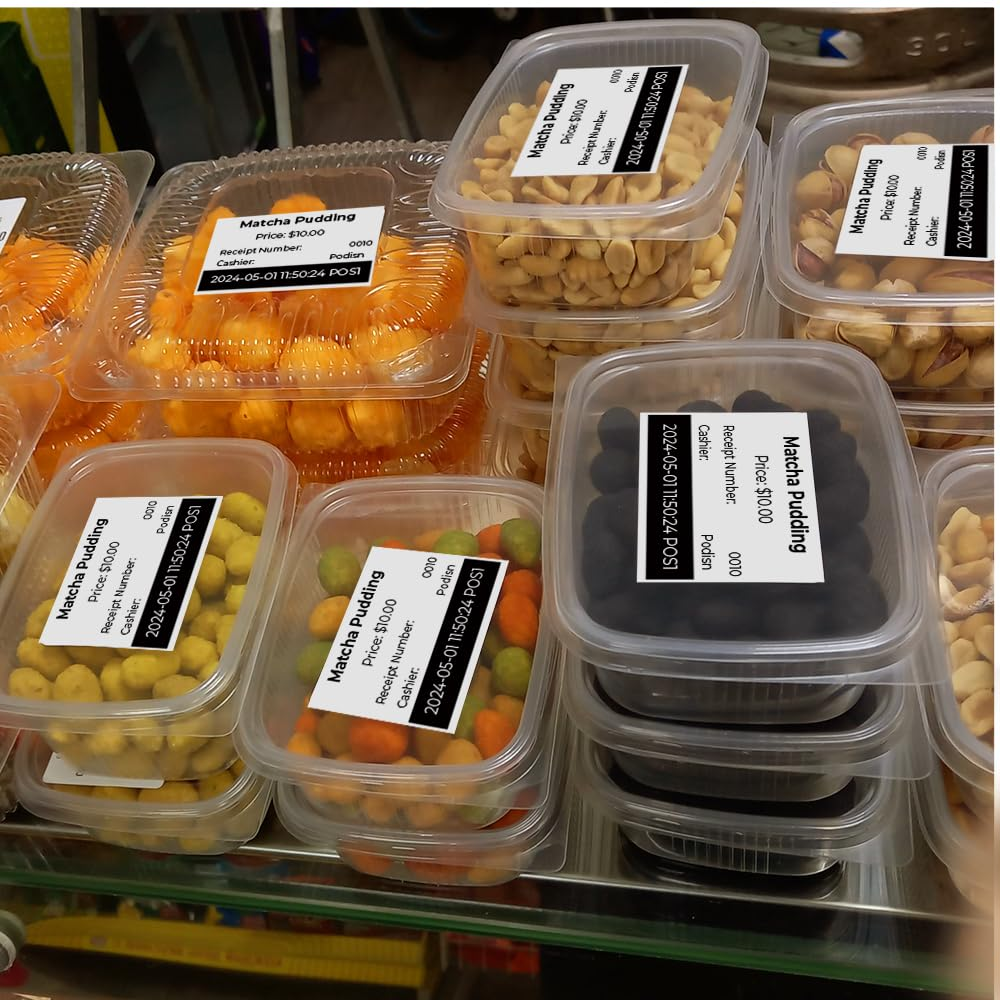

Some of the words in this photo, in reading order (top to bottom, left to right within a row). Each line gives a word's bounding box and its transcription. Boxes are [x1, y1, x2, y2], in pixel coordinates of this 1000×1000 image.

[527, 123, 554, 158] Matcha
[543, 84, 574, 121] Pudding
[568, 99, 588, 122] $10.00
[598, 138, 616, 165] Cashier:
[624, 73, 640, 92] Podisn
[626, 121, 652, 164] 2024-05-01
[641, 91, 661, 118] 11:50:24
[651, 72, 668, 89] POS1
[560, 123, 578, 144] Price:
[578, 140, 597, 165] Receipt
[588, 110, 607, 138] Number:
[962, 150, 975, 167] POS1
[858, 159, 883, 195] Pudding
[884, 175, 899, 197] $10.00
[849, 198, 870, 233] Matcha
[880, 199, 895, 220] Price:
[908, 187, 922, 216] Number:
[240, 218, 291, 228] Matcha
[295, 213, 356, 224] Pudding
[256, 232, 286, 240] Price:
[288, 229, 325, 238] $10.00
[904, 218, 920, 245] Receipt
[925, 217, 939, 246] Cashier:
[957, 200, 973, 248] 2024-05-01
[220, 248, 257, 256] Receipt
[259, 245, 302, 253] Number:
[329, 252, 364, 260] Podisn
[211, 272, 277, 283] 2024-05-01
[281, 270, 324, 279] 11:50:24
[330, 267, 360, 276] POS1
[663, 424, 677, 486] 2024-05-01
[698, 425, 711, 460] Cashier:
[721, 426, 737, 459] Receipt
[755, 456, 769, 485] Price:
[783, 437, 804, 486] Matcha
[725, 463, 739, 504] Number:
[663, 490, 677, 534] 11:50:24
[754, 488, 773, 524] $10.00
[788, 491, 809, 553] Pudding
[56, 573, 85, 619] Matcha
[76, 519, 109, 569] Pudding
[101, 600, 121, 633] Receipt
[114, 558, 136, 596] Number:
[143, 501, 157, 520] 0010
[121, 599, 141, 635] Cashier:
[156, 506, 174, 534] Podisn
[663, 538, 678, 569] POS1
[701, 535, 715, 570] Podisn
[729, 552, 742, 576] 0010
[88, 575, 108, 602] Price:
[99, 542, 120, 572] $10.00
[146, 576, 177, 637] 2024-05-01
[168, 534, 191, 572] 11:50:24
[182, 506, 201, 531] POS1
[327, 631, 359, 682] Matcha
[349, 571, 385, 627] Pudding
[362, 636, 383, 666] Price:
[373, 599, 397, 633] $10.00
[375, 666, 398, 704] Receipt
[390, 620, 414, 663] Number:
[422, 557, 437, 578] 0010
[397, 668, 419, 708] Cashier:
[436, 565, 455, 596] Podisn
[425, 645, 459, 714] 2024-05-01
[448, 600, 473, 641] 11:50:24
[464, 568, 484, 596] POS1
